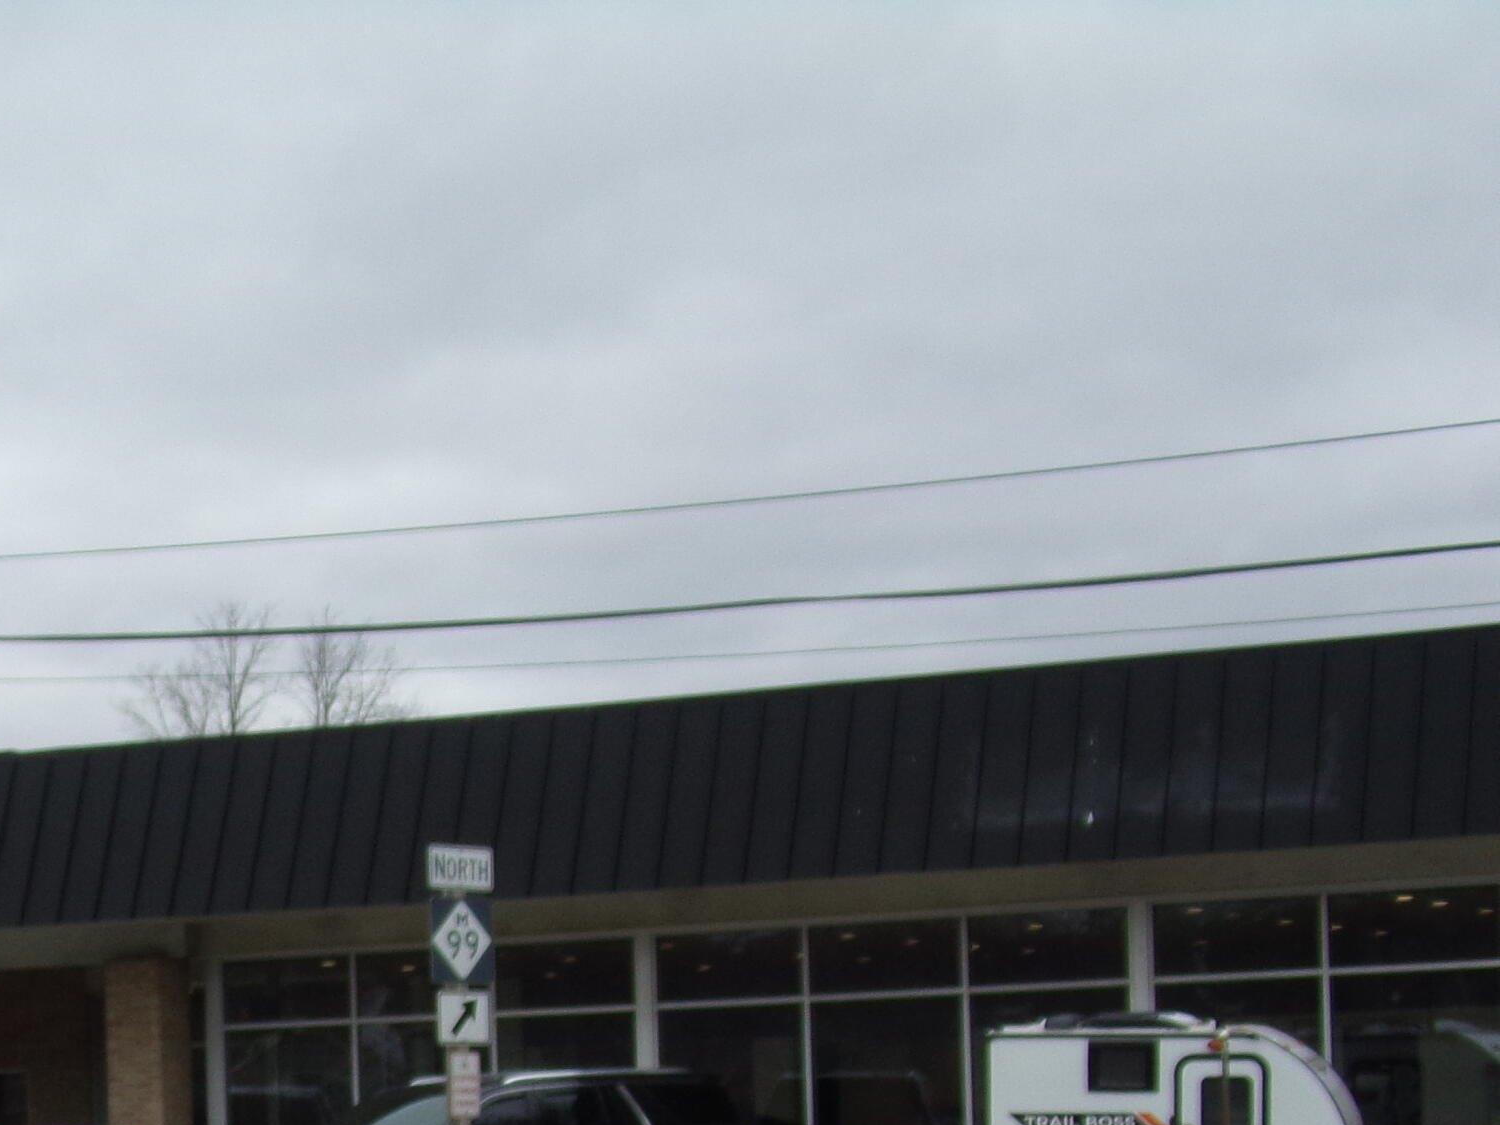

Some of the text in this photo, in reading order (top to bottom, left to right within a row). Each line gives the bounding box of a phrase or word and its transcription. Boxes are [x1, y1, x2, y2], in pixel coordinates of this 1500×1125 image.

[434, 853, 489, 882] NORTH
[456, 911, 469, 927] M
[447, 930, 480, 960] 99
